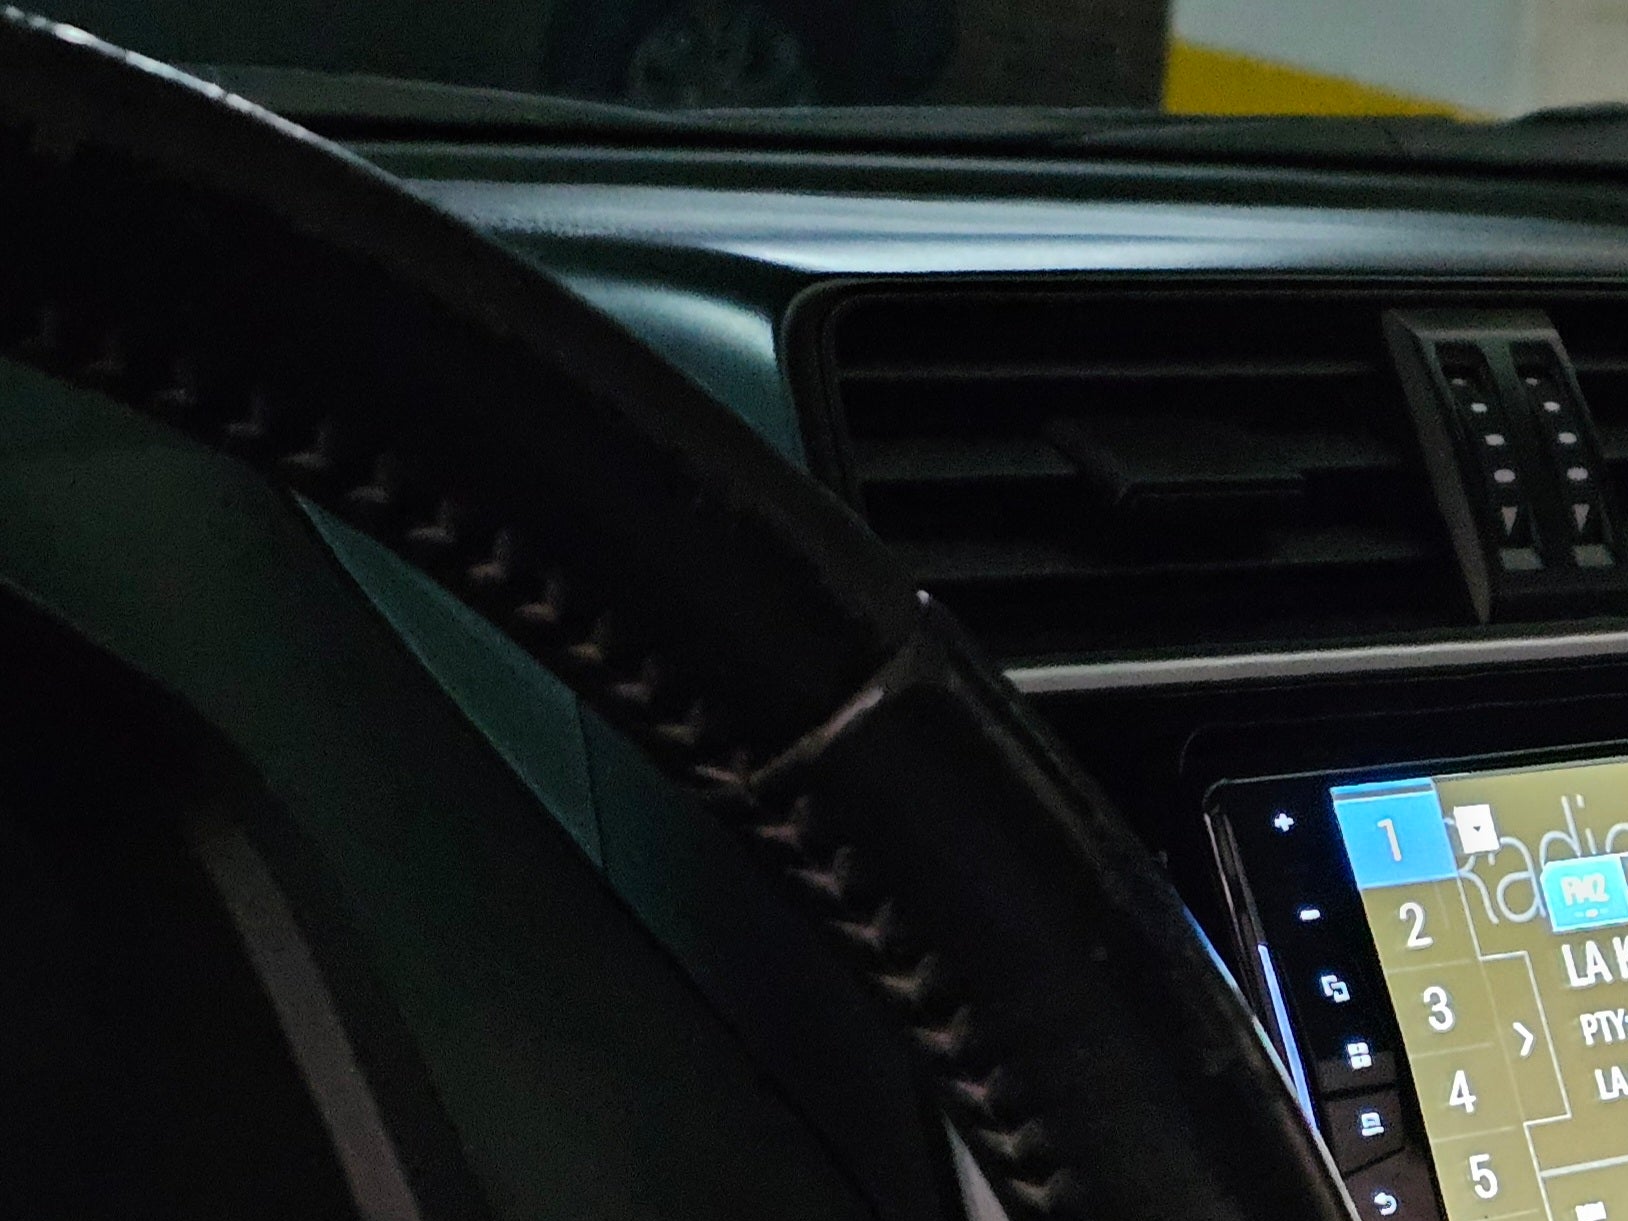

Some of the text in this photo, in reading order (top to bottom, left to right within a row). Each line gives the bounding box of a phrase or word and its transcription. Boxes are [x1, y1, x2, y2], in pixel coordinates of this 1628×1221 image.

[1377, 818, 1402, 862] 1
[1400, 902, 1433, 948] 2
[1561, 939, 1613, 987] LA
[1423, 986, 1454, 1031] 3
[1449, 1069, 1477, 1113] 4
[1469, 1153, 1498, 1199] 5
